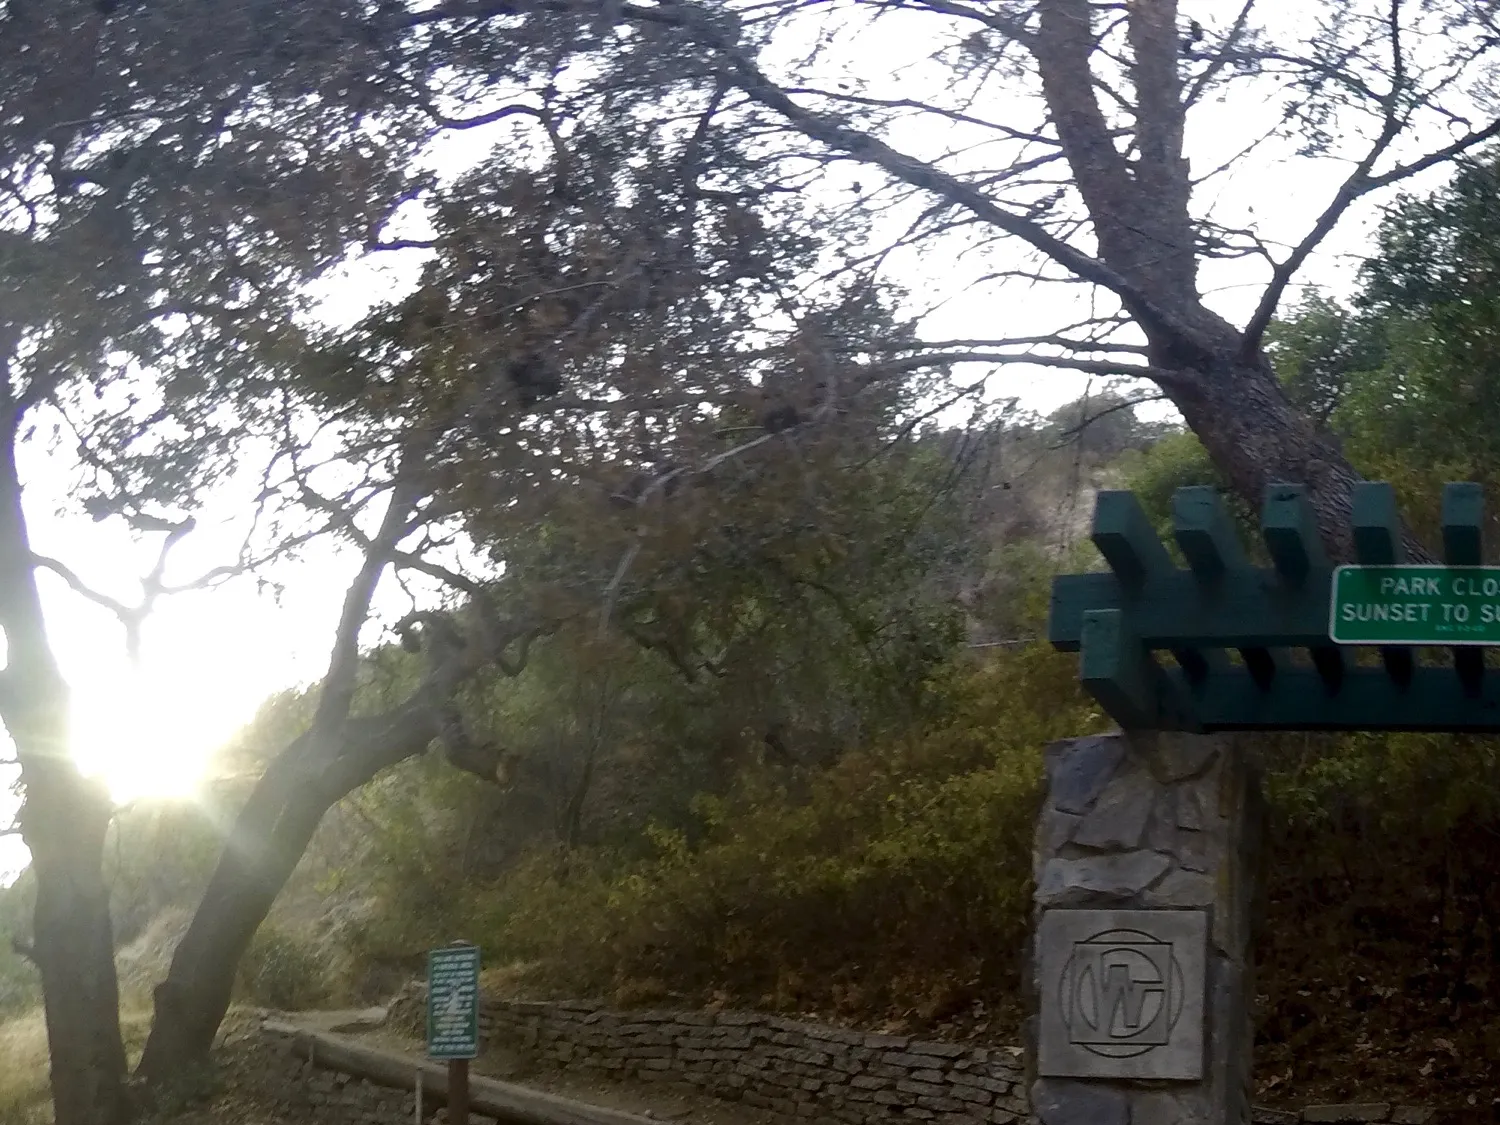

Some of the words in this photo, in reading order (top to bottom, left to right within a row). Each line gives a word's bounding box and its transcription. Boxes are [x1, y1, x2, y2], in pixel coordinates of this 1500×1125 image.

[1380, 577, 1441, 596] PARK
[1342, 602, 1431, 622] SUNSET
[1440, 603, 1470, 622] TO
